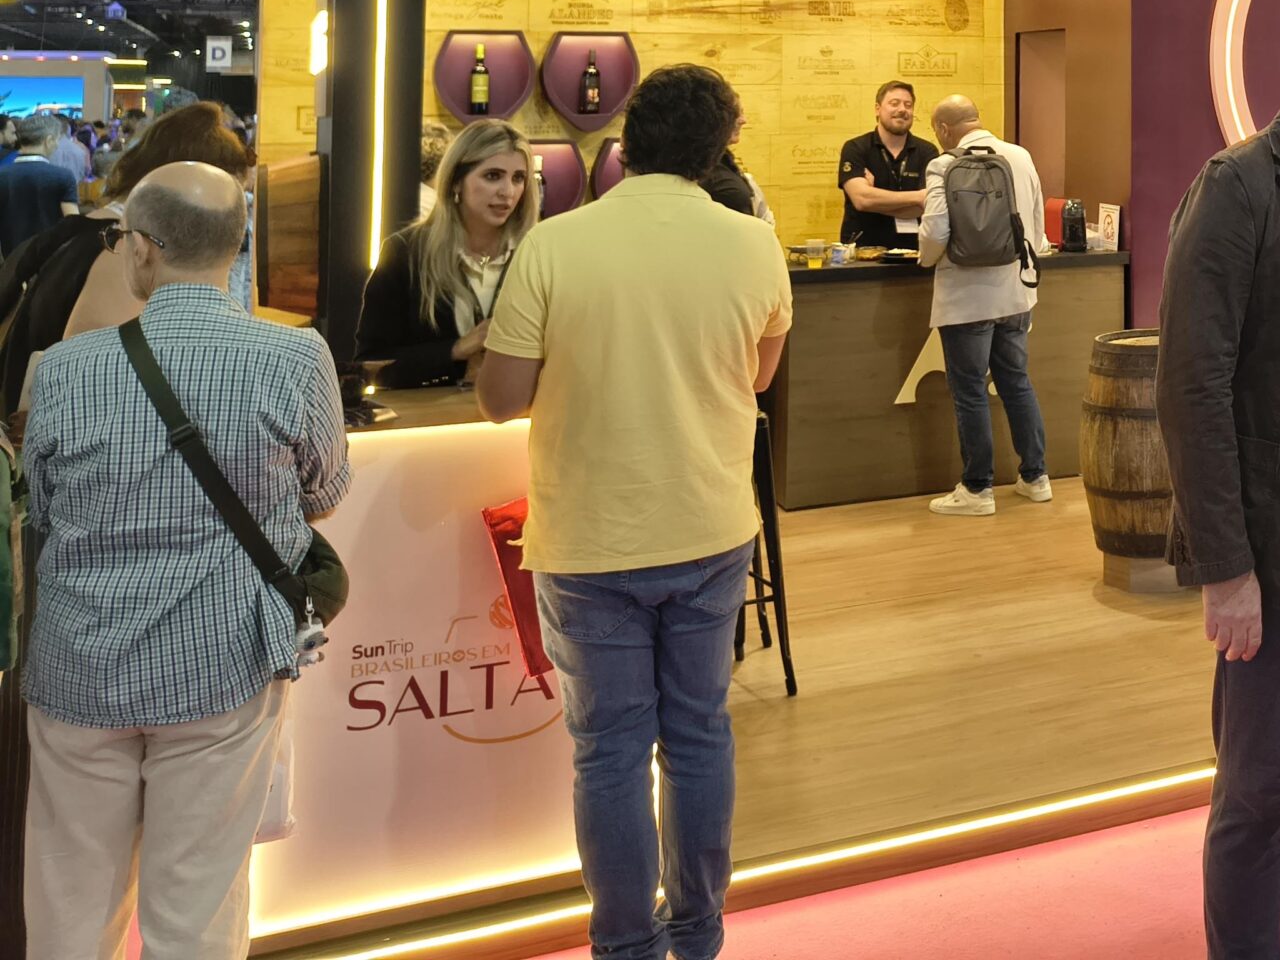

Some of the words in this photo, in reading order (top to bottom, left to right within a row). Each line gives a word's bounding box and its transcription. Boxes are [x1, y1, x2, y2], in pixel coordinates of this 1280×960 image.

[211, 46, 226, 61] D
[351, 648, 478, 678] BRASILEIROS
[482, 643, 510, 661] EM
[347, 661, 555, 731] SALTA
